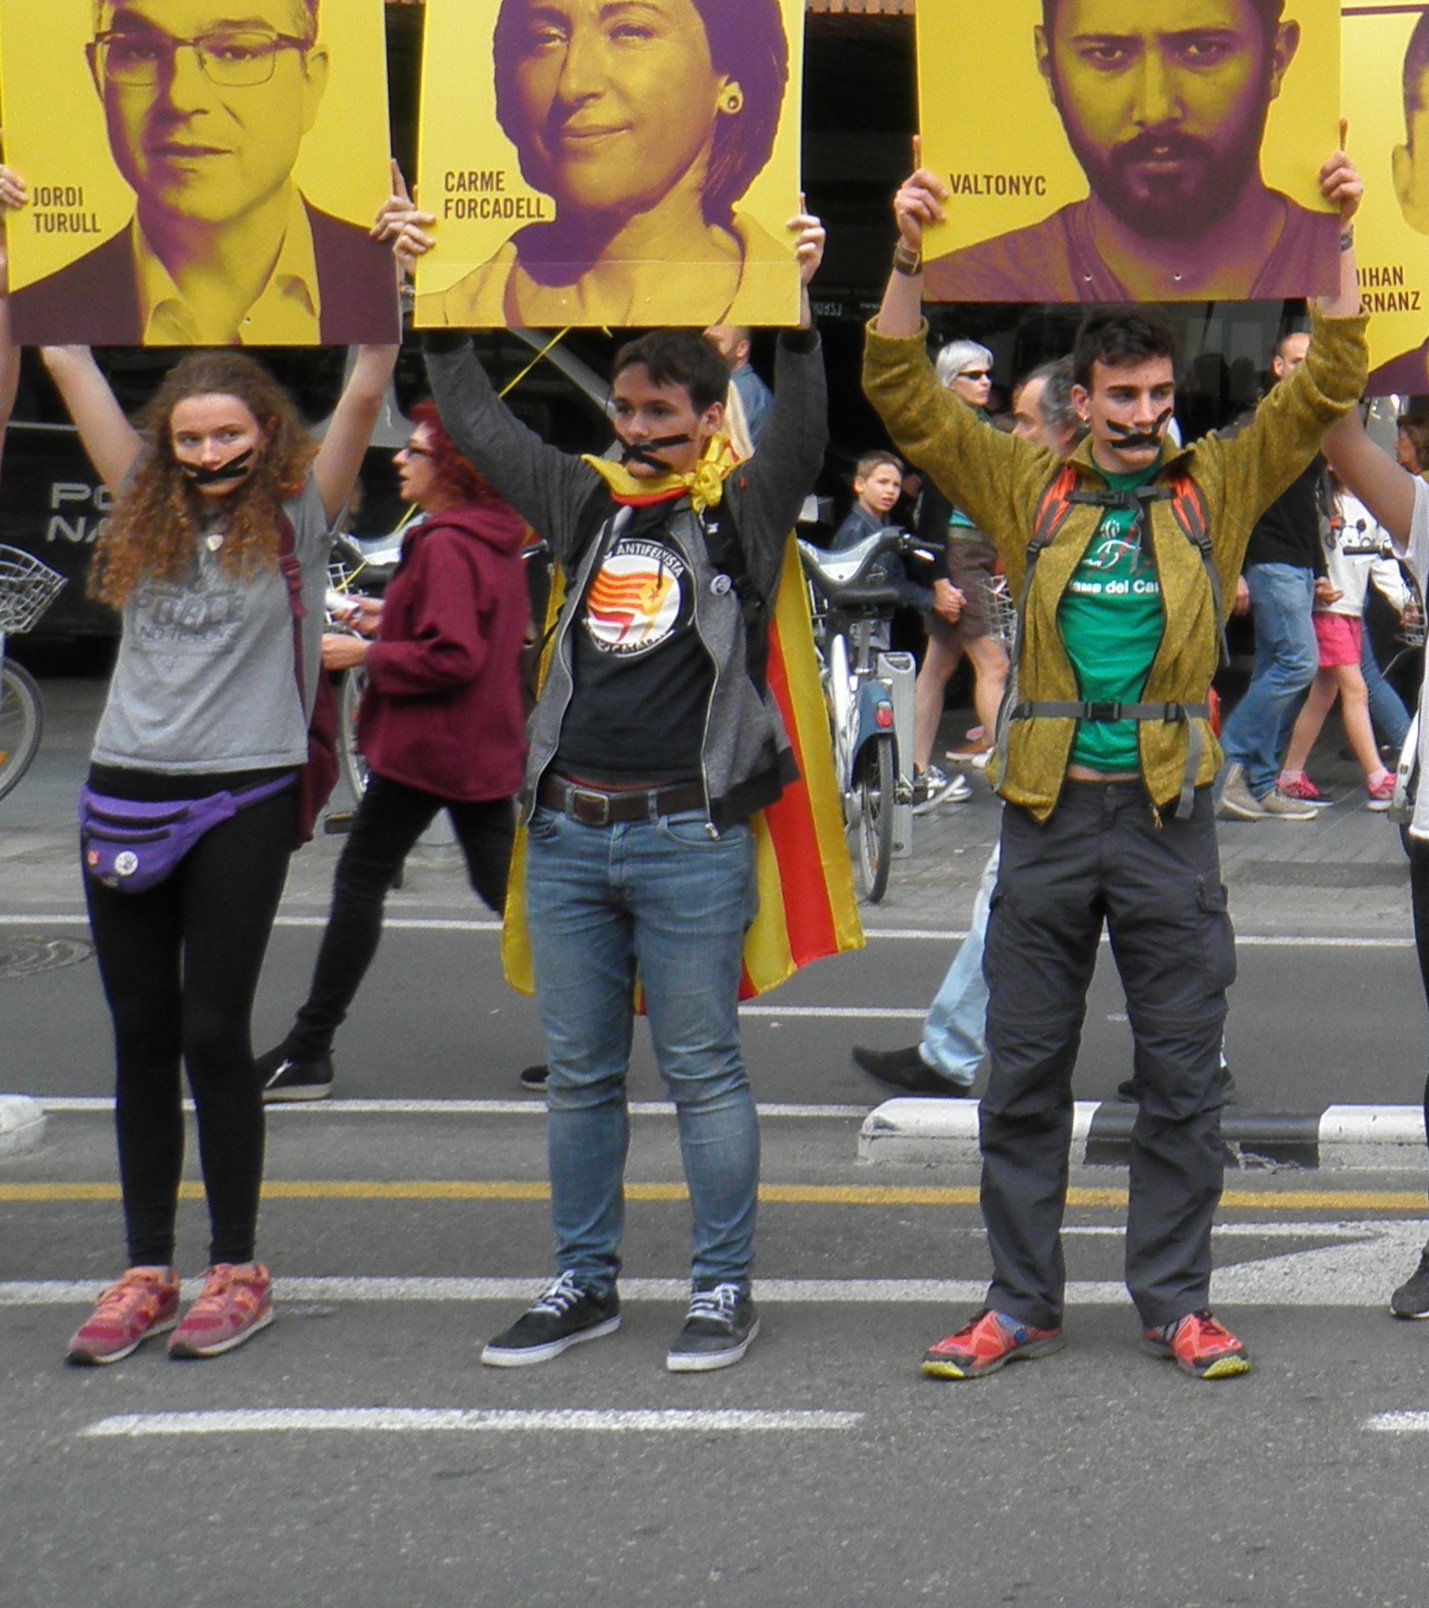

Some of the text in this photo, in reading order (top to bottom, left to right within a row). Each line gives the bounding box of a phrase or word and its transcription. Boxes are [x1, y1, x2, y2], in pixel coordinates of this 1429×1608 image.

[444, 171, 506, 193] CARME
[949, 174, 1047, 197] VALTONYC
[32, 187, 84, 207] JORDI
[444, 196, 546, 220] FORCADELL
[34, 212, 102, 233] TURULL
[1360, 291, 1421, 313] RNANZ
[1105, 579, 1130, 594] del
